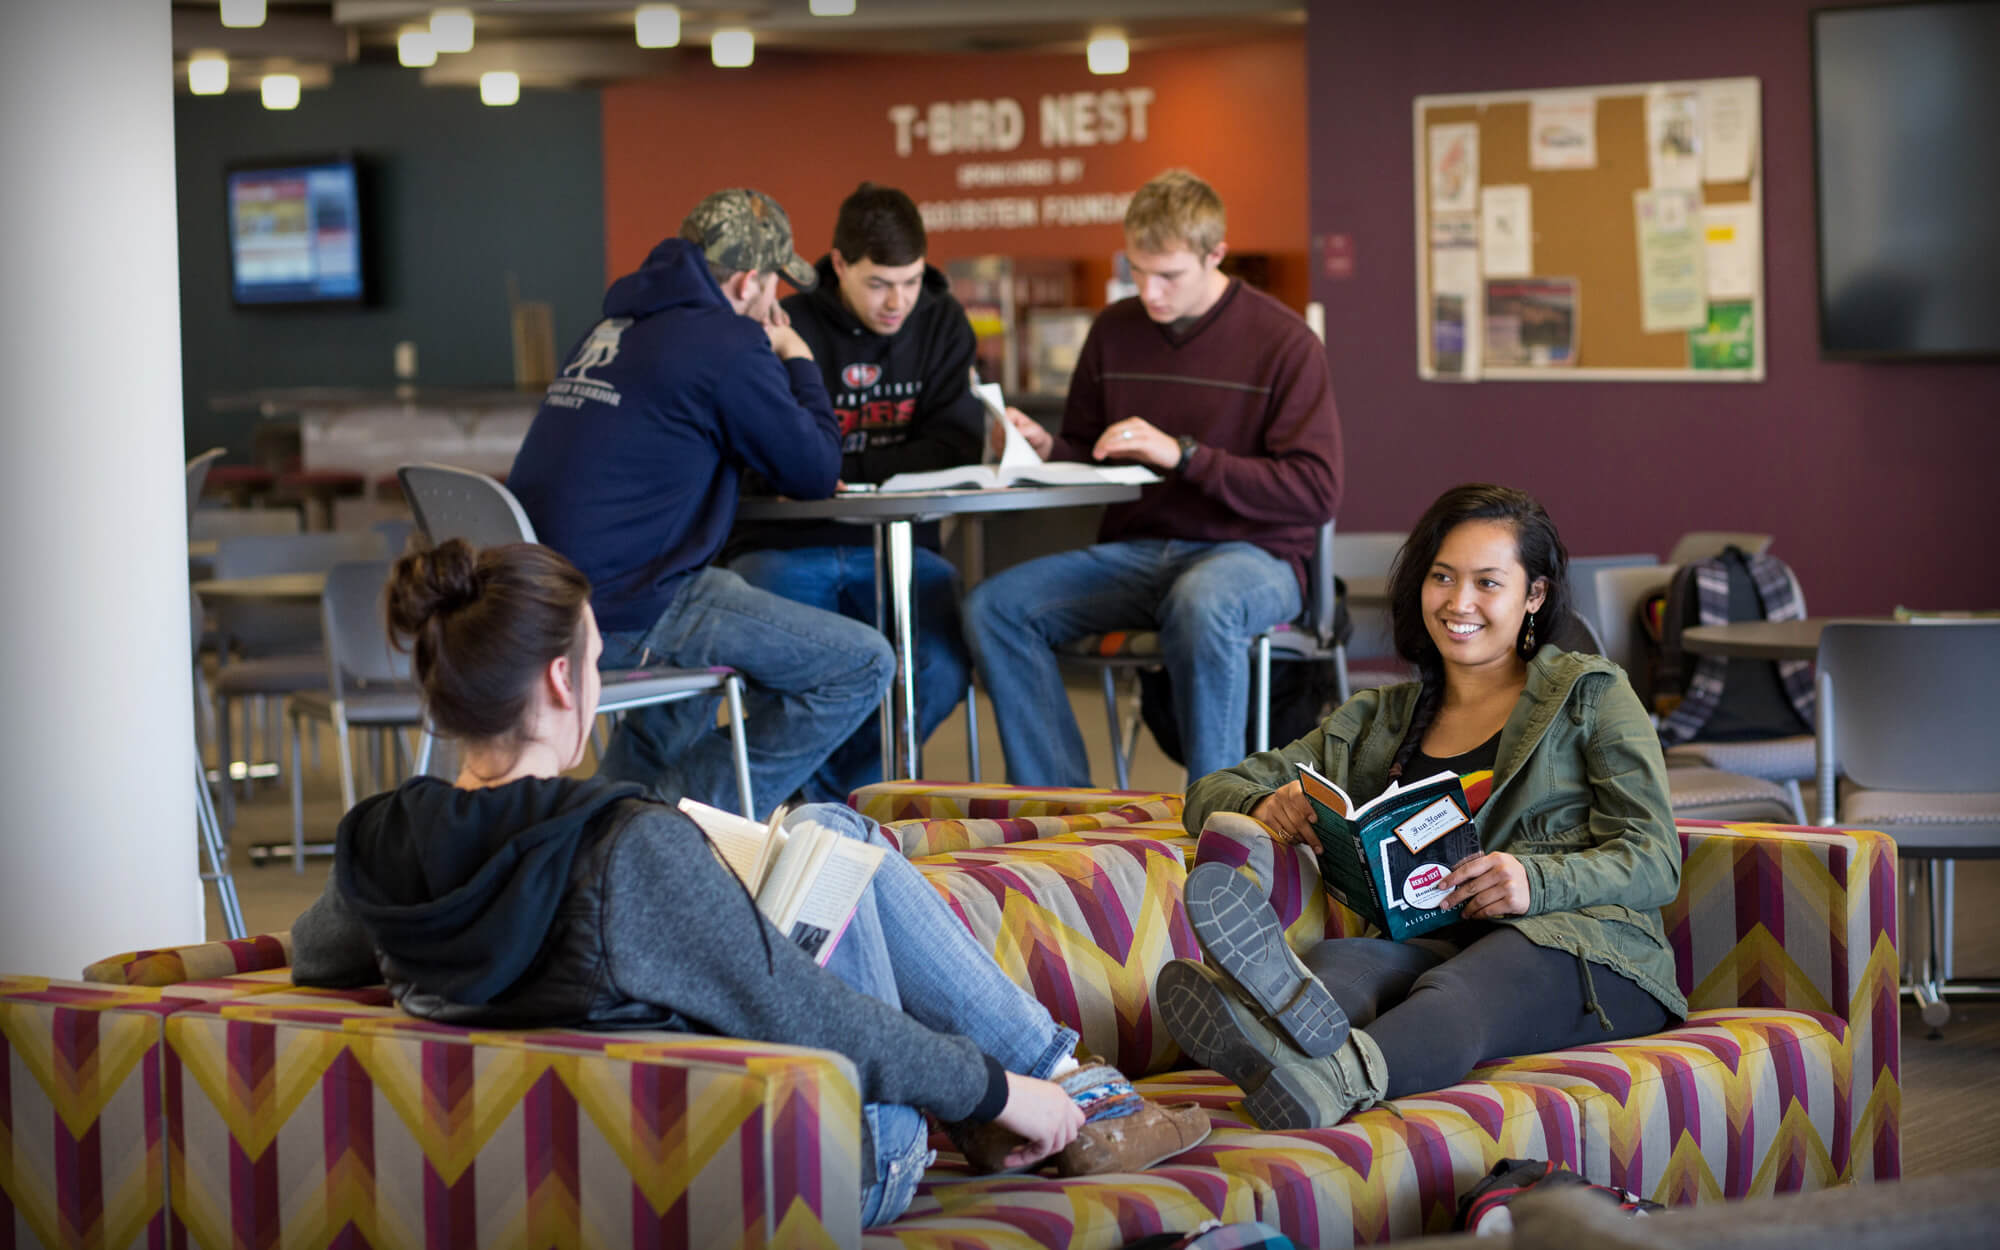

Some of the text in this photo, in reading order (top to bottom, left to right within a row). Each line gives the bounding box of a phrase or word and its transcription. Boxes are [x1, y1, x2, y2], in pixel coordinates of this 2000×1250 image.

[1041, 88, 1154, 147] NEST
[1424, 809, 1449, 827] Home
[1405, 911, 1437, 928] ALISON
